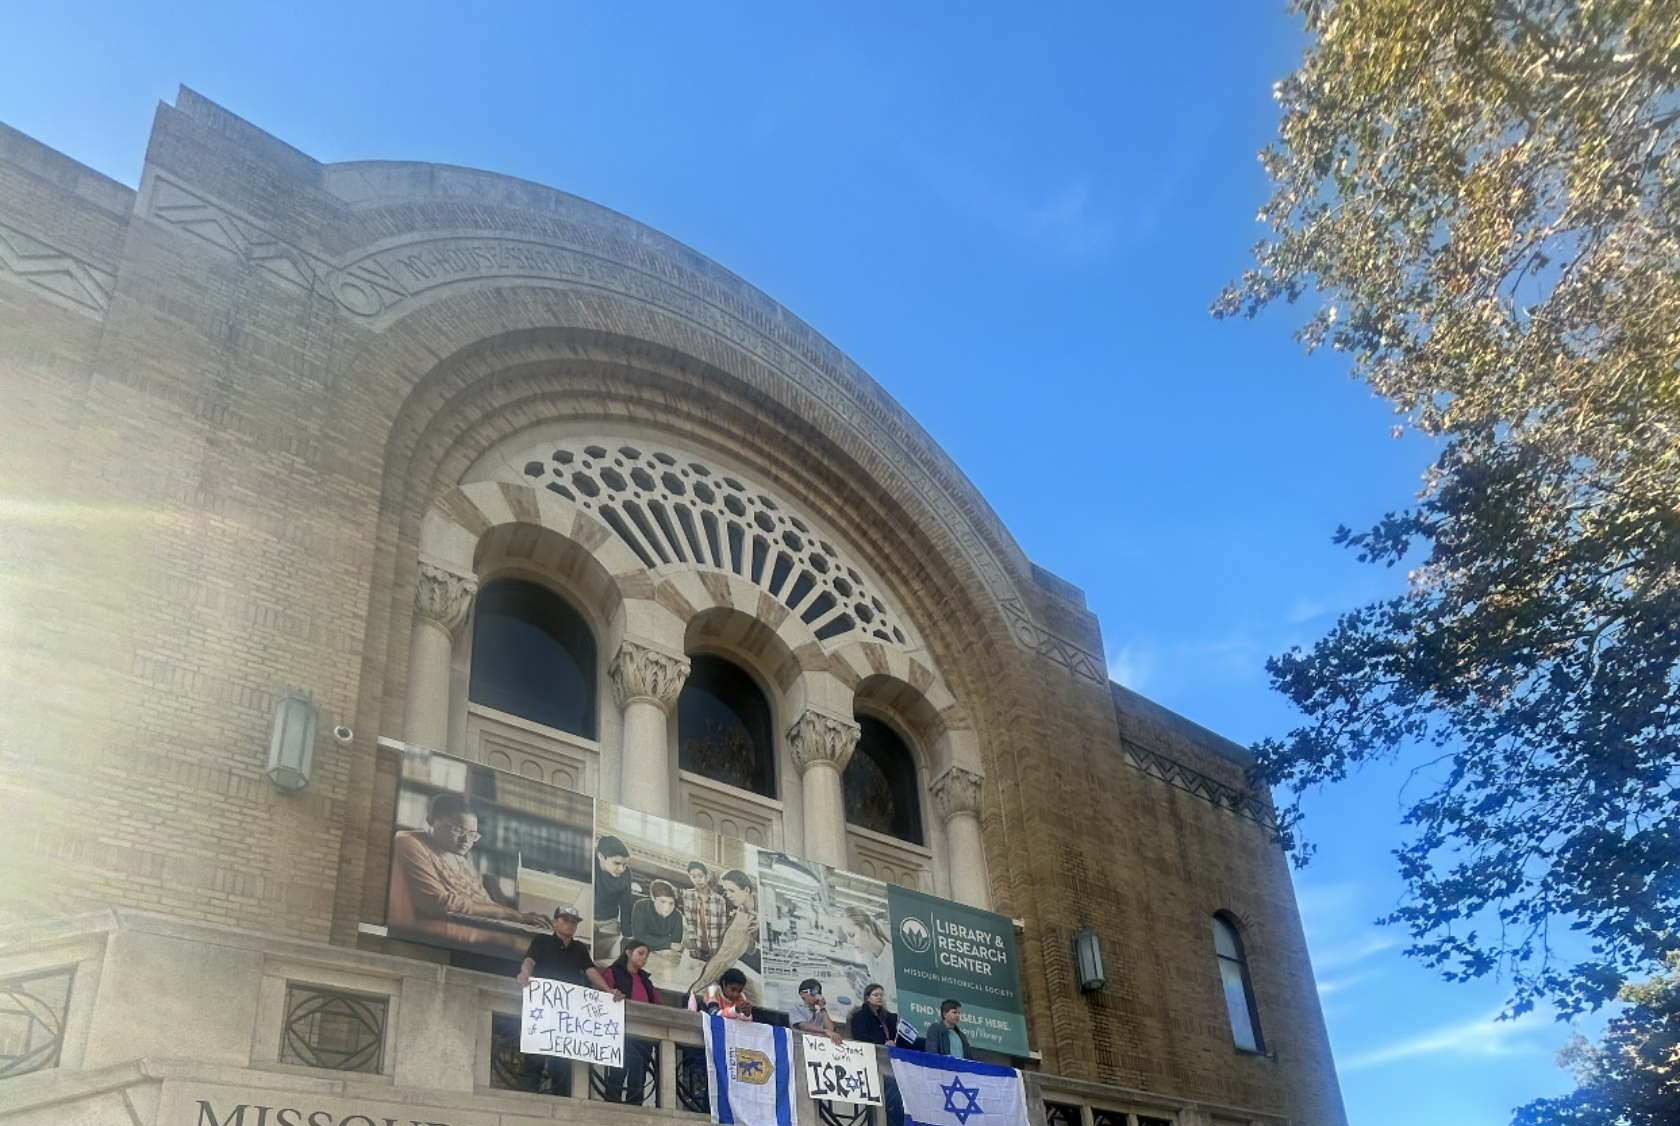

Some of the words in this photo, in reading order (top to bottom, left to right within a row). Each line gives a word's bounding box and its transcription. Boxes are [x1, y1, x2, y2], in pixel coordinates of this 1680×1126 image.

[936, 919, 992, 944] LIBRARY
[994, 935, 1005, 949] &
[938, 936, 1008, 964] RESEARCH
[939, 953, 993, 976] CENTER
[528, 980, 575, 1010] PRAY
[583, 989, 603, 1003] FOR
[903, 967, 940, 981] MISSOURI
[941, 976, 984, 992] HISTORICAL
[985, 986, 1014, 998] SOCIETY
[558, 1011, 604, 1036] PEACE
[581, 1004, 609, 1018] THE
[910, 1002, 934, 1015] FIND
[985, 1018, 1012, 1031] HERE.
[539, 1028, 622, 1065] JERUSALEM
